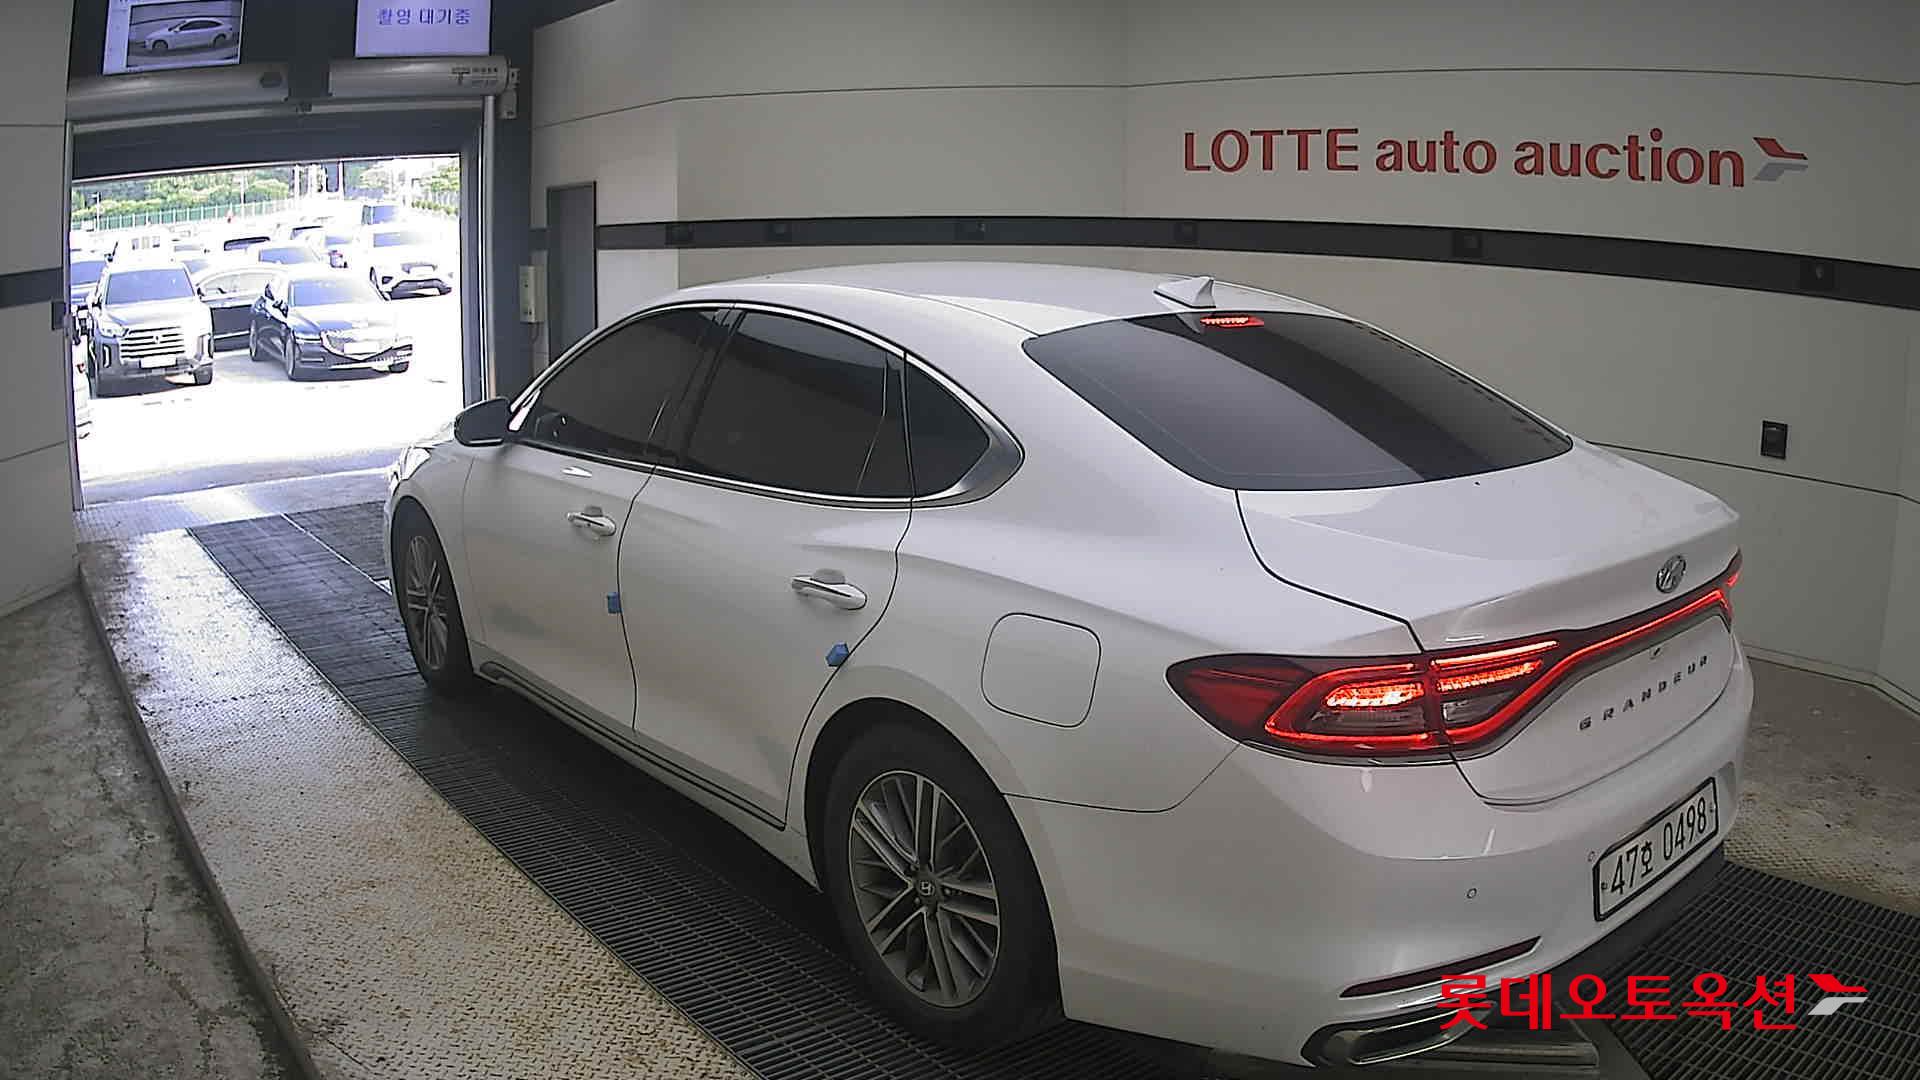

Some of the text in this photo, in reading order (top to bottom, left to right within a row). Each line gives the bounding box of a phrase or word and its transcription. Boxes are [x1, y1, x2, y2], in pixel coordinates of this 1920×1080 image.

[377, 8, 471, 26] 촬영 대기중
[1184, 127, 1745, 188] LOTTE auto auction
[1578, 655, 1708, 731] GRANDEUR
[1610, 796, 1707, 895] 47호 0498
